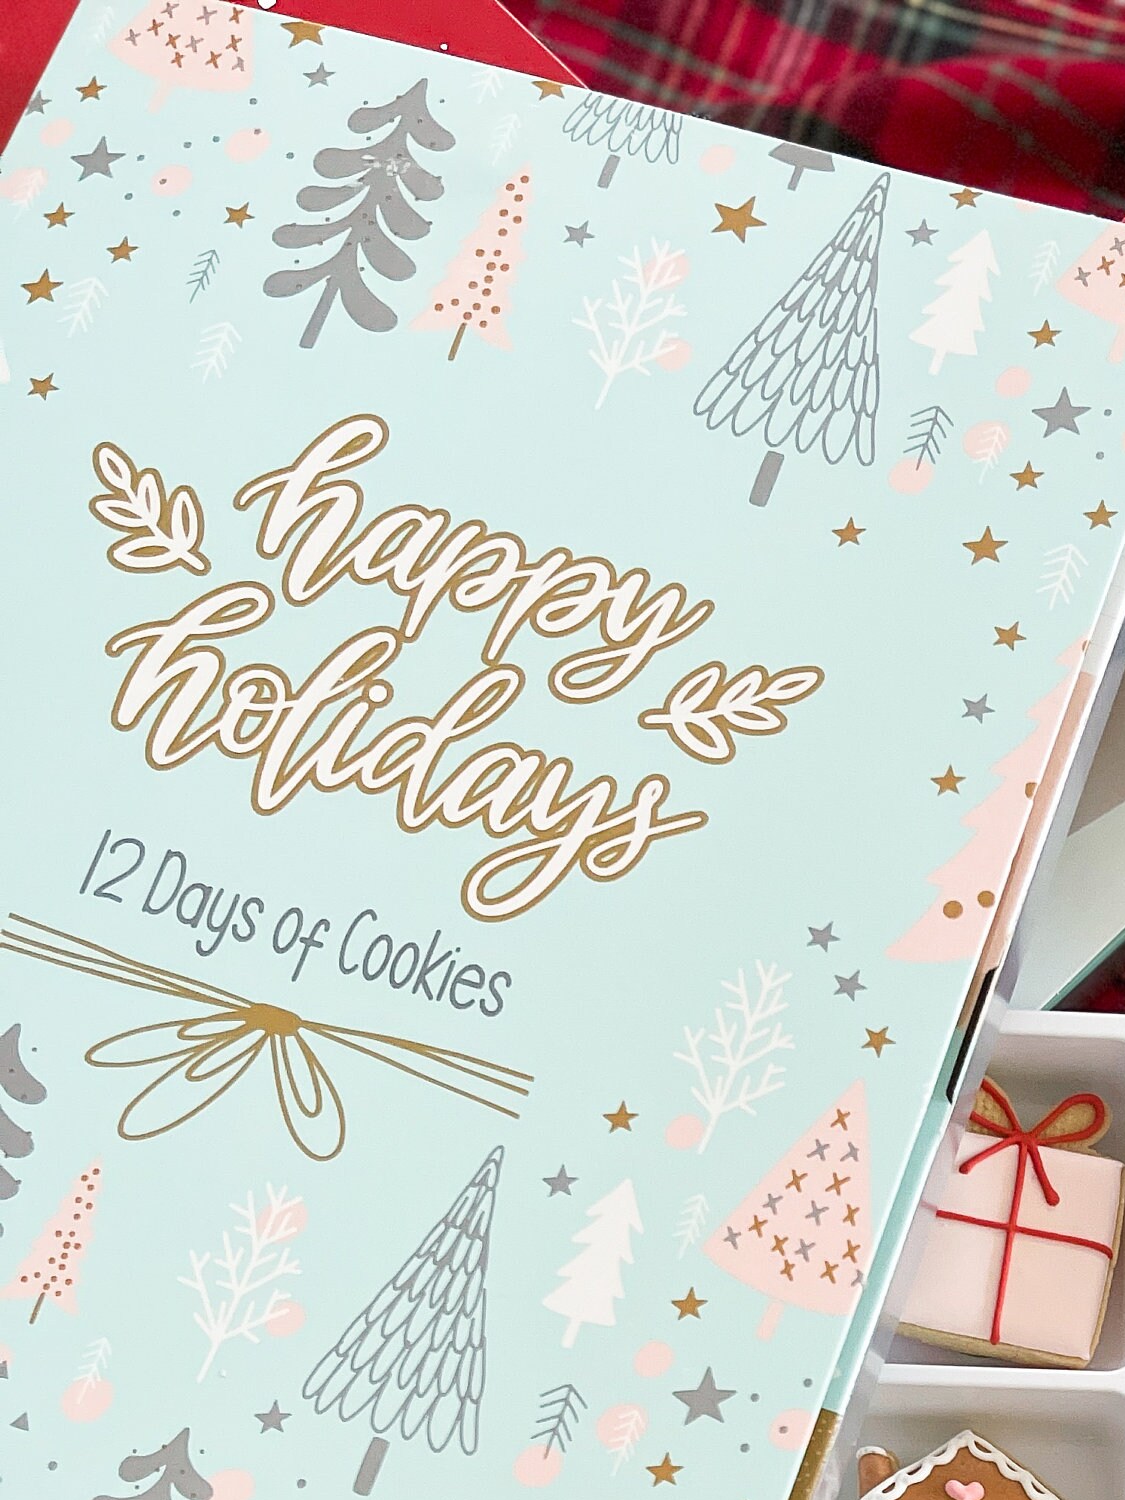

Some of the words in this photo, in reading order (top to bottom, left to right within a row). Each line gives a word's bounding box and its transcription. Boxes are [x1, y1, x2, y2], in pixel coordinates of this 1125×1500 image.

[233, 413, 716, 704] happy
[105, 581, 710, 923] holidays
[79, 828, 145, 905] 12
[142, 848, 265, 956] Days
[272, 904, 332, 983] of
[338, 907, 514, 1019] Cookies
